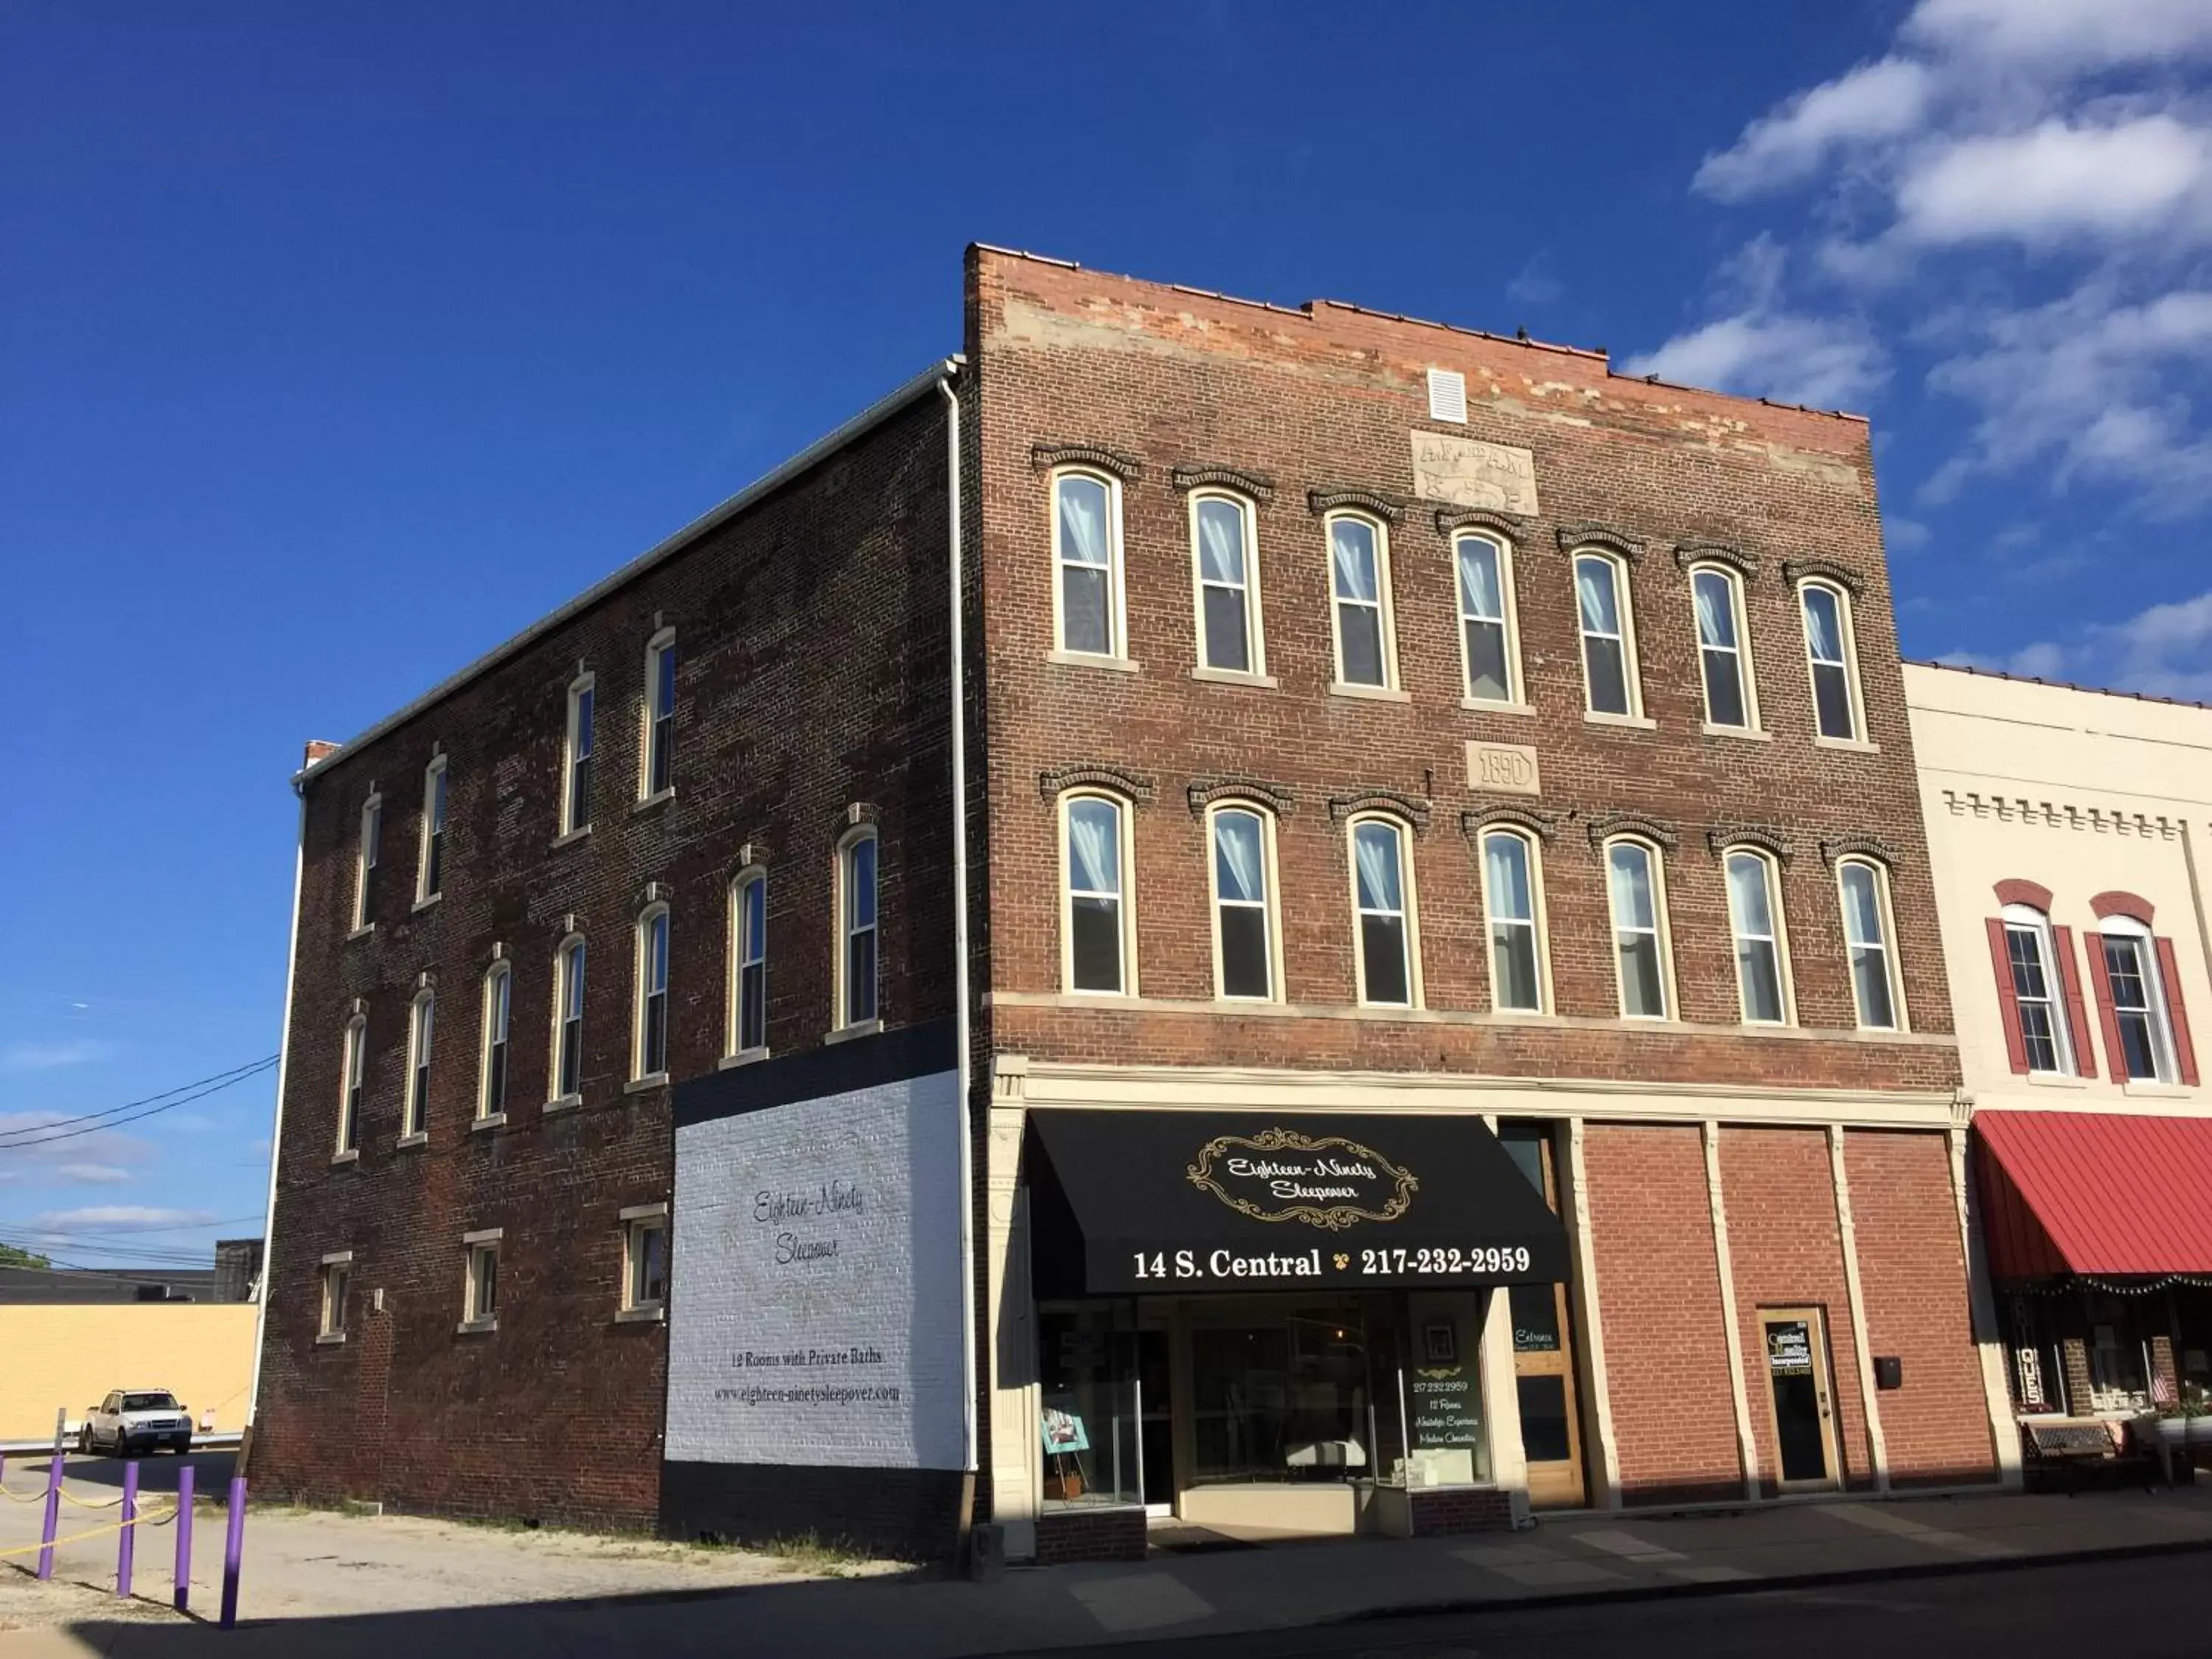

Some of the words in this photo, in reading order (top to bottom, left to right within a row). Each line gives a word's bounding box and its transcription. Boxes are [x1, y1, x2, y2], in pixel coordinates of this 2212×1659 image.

[1479, 752, 1525, 786] 1890
[1227, 1158, 1376, 1179] Eighteen-Ninety
[1270, 1180, 1359, 1201] Sleepover
[1133, 1251, 1167, 1279] 14
[1175, 1250, 1204, 1278] S.
[1209, 1248, 1323, 1277] Central
[1361, 1247, 1531, 1274] 217-232-2959
[745, 1351, 780, 1366] Rooms
[782, 1349, 806, 1366] with
[809, 1349, 848, 1366] Private
[850, 1346, 883, 1365] Baths
